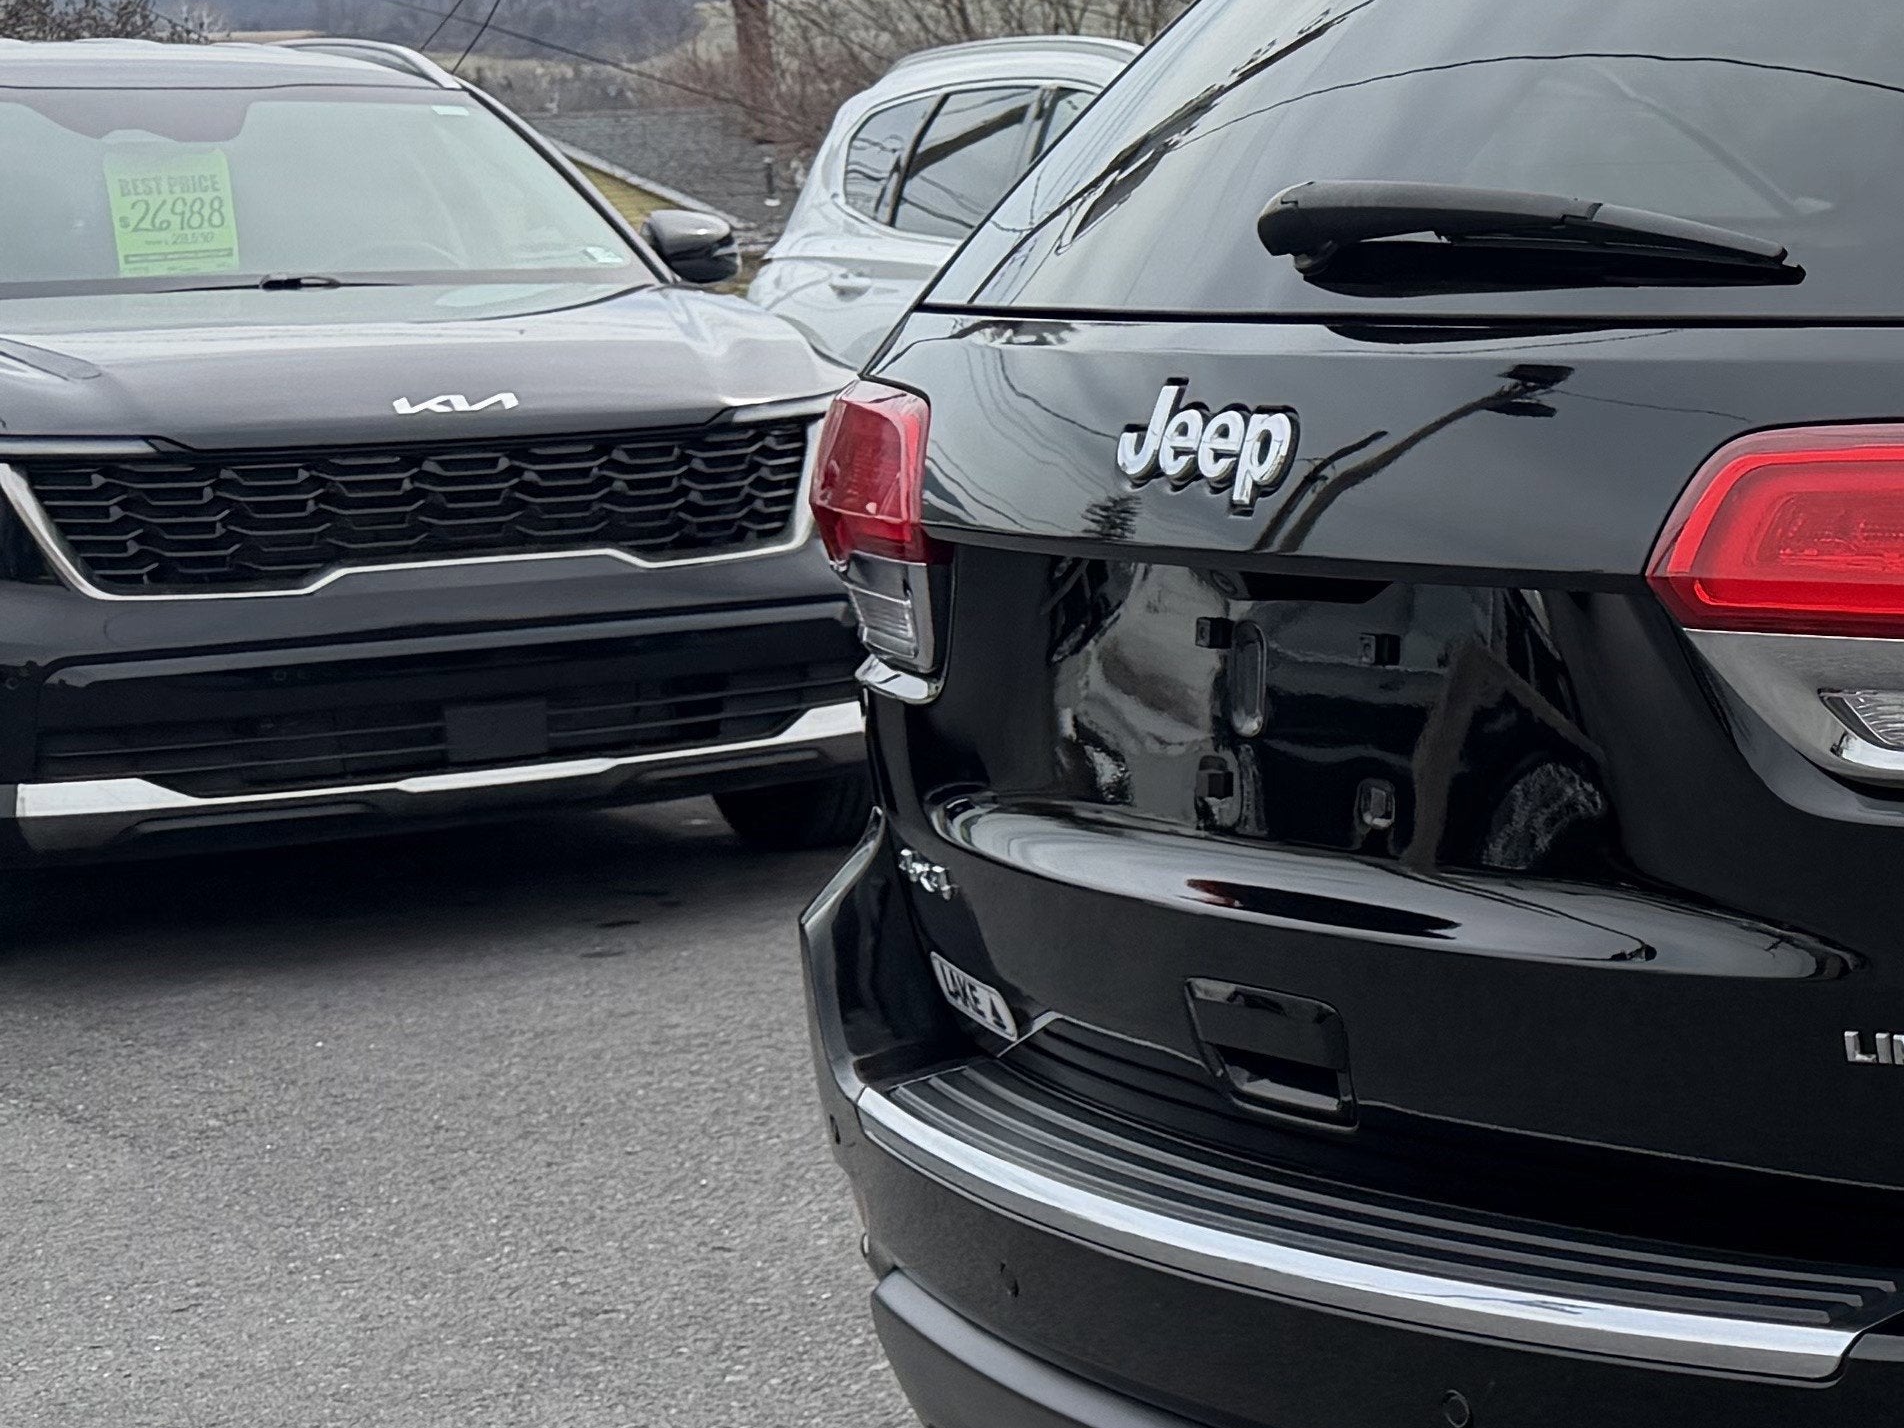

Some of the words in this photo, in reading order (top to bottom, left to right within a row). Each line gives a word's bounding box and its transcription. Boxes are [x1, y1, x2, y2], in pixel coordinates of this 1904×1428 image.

[118, 178, 163, 197] BEST
[167, 174, 221, 195] PRICE
[1117, 380, 1299, 512] Jeep
